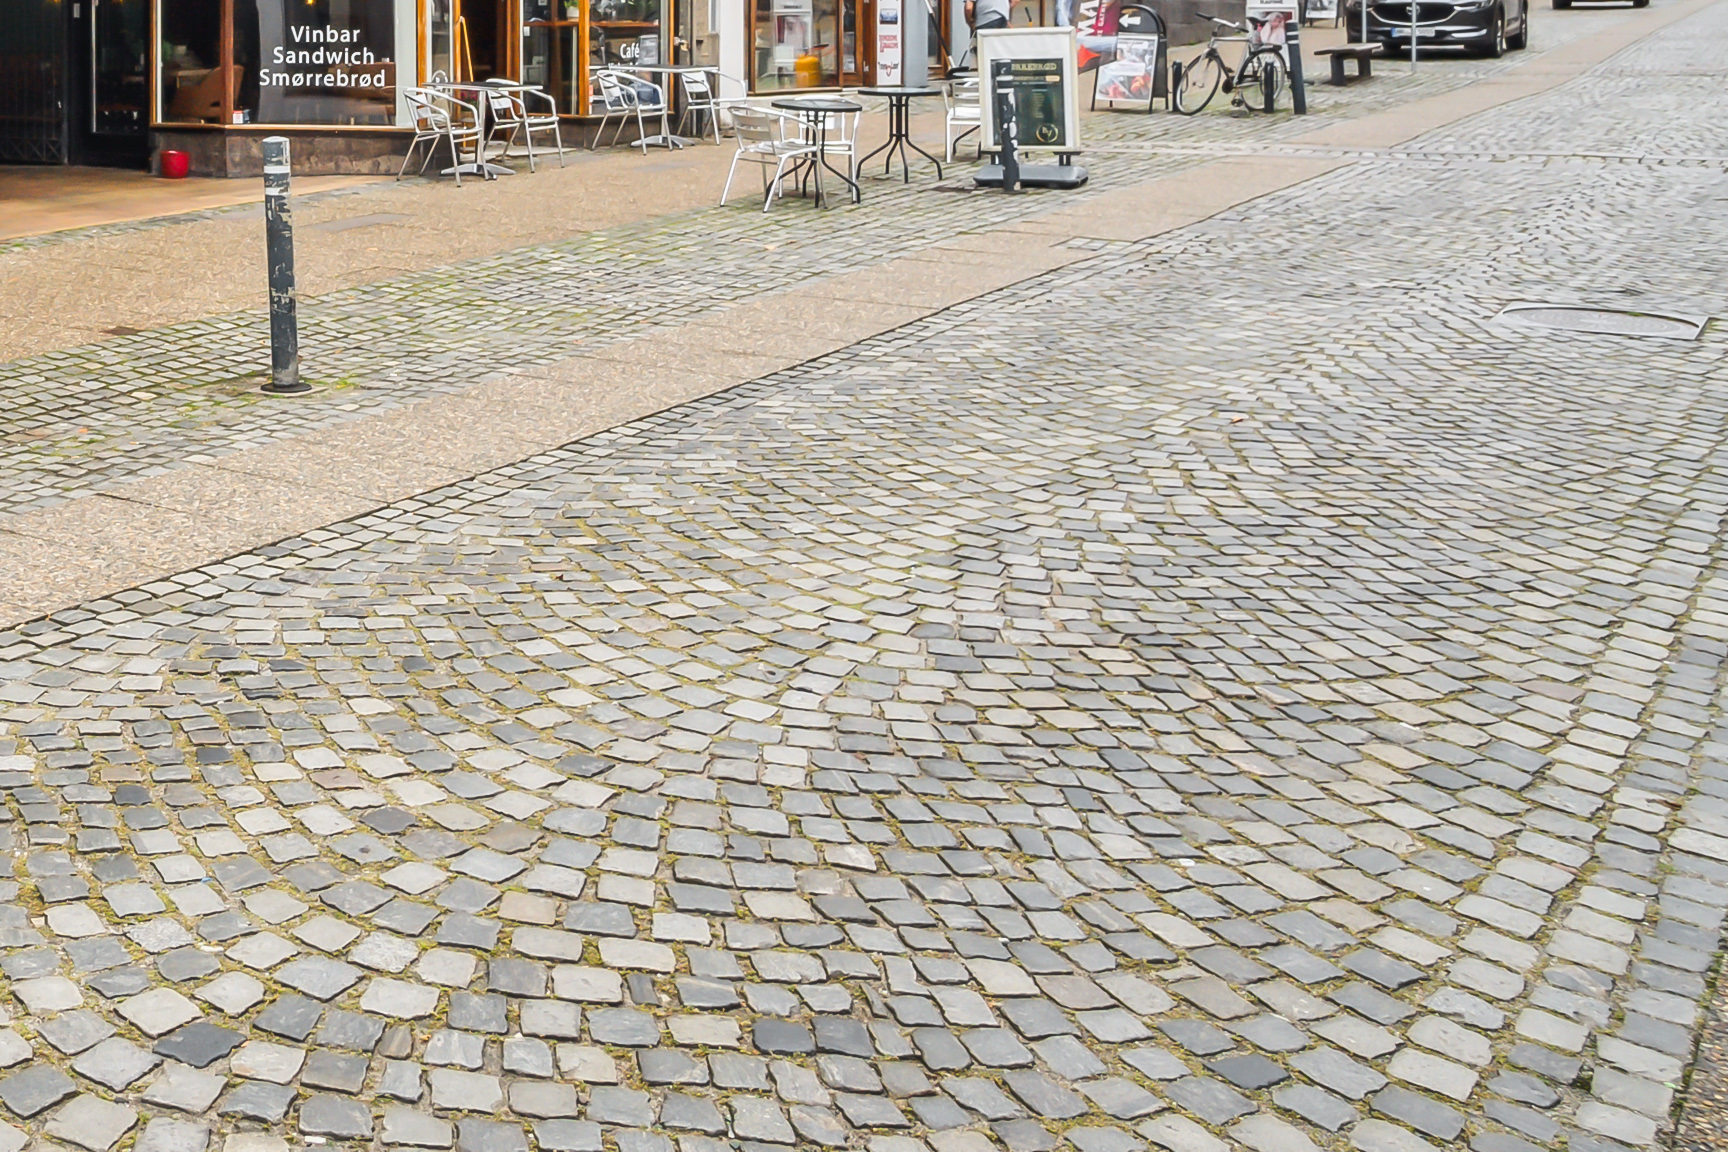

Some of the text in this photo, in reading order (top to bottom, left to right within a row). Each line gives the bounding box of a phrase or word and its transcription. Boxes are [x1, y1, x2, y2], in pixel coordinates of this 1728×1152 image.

[290, 24, 361, 43] Vinbar
[273, 46, 375, 65] Sandwich
[620, 42, 640, 59] Café
[259, 68, 386, 87] Smørrebrød
